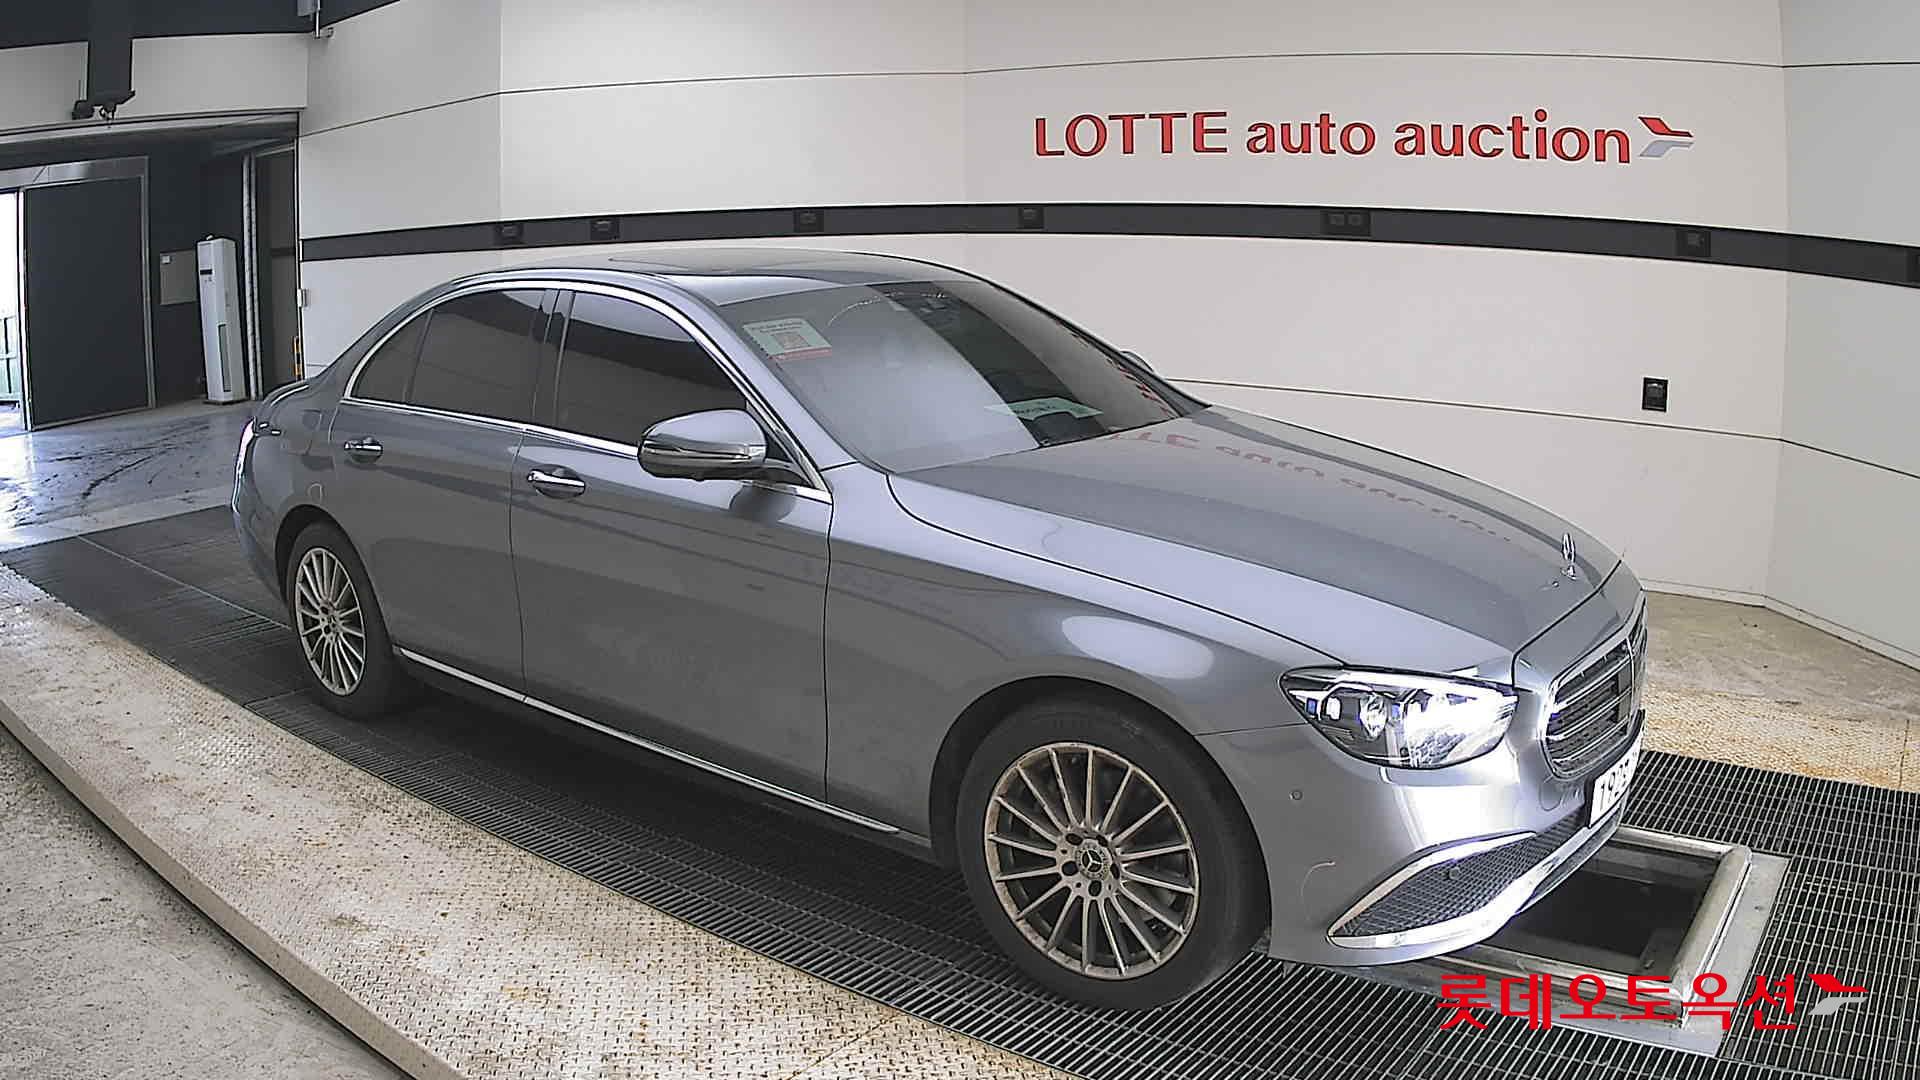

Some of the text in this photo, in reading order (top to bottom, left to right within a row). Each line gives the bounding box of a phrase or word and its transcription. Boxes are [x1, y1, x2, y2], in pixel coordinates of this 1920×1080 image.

[1035, 108, 1631, 165] LOTTE auto auction
